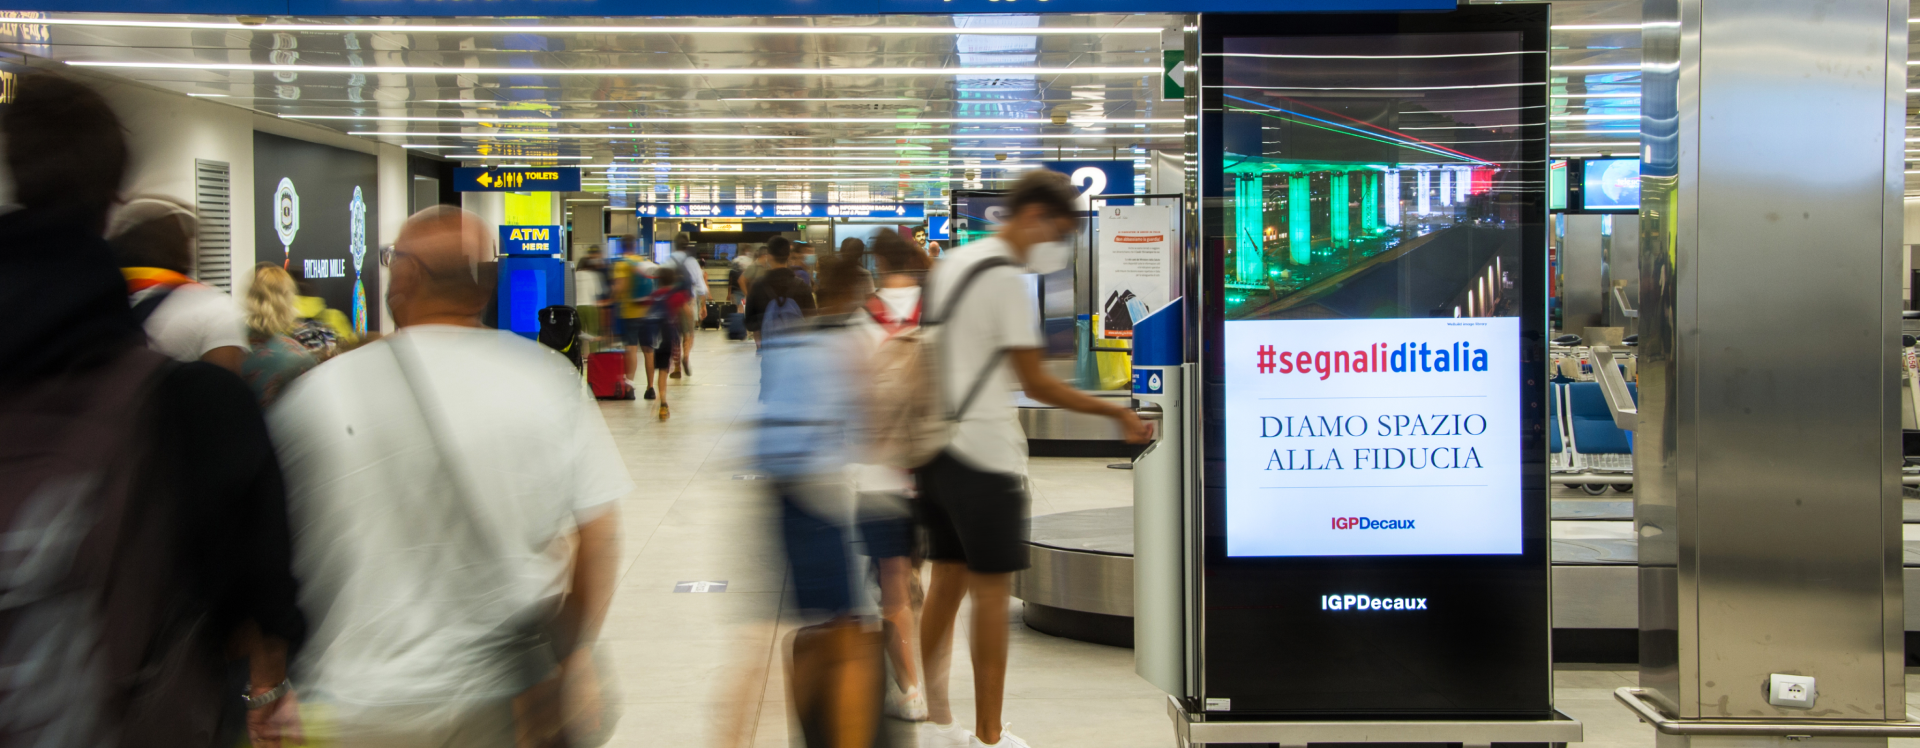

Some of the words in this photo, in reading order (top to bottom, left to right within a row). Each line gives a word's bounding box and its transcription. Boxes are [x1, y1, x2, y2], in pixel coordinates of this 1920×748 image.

[524, 172, 559, 180] TOILETS
[1070, 166, 1107, 212] 2
[509, 228, 550, 240] ATM
[522, 243, 550, 251] HERE
[304, 259, 328, 278] RICHARD
[330, 259, 345, 277] MILLE
[1257, 341, 1489, 381] #segnaliditalia
[1259, 415, 1368, 438] DIAMO
[1377, 413, 1487, 437] SPAZIO
[1264, 448, 1345, 471] ALLA
[1353, 446, 1484, 470] FIDUCIA
[1331, 516, 1416, 530] IGPDecaux
[1321, 594, 1428, 610] IGPDecaux
